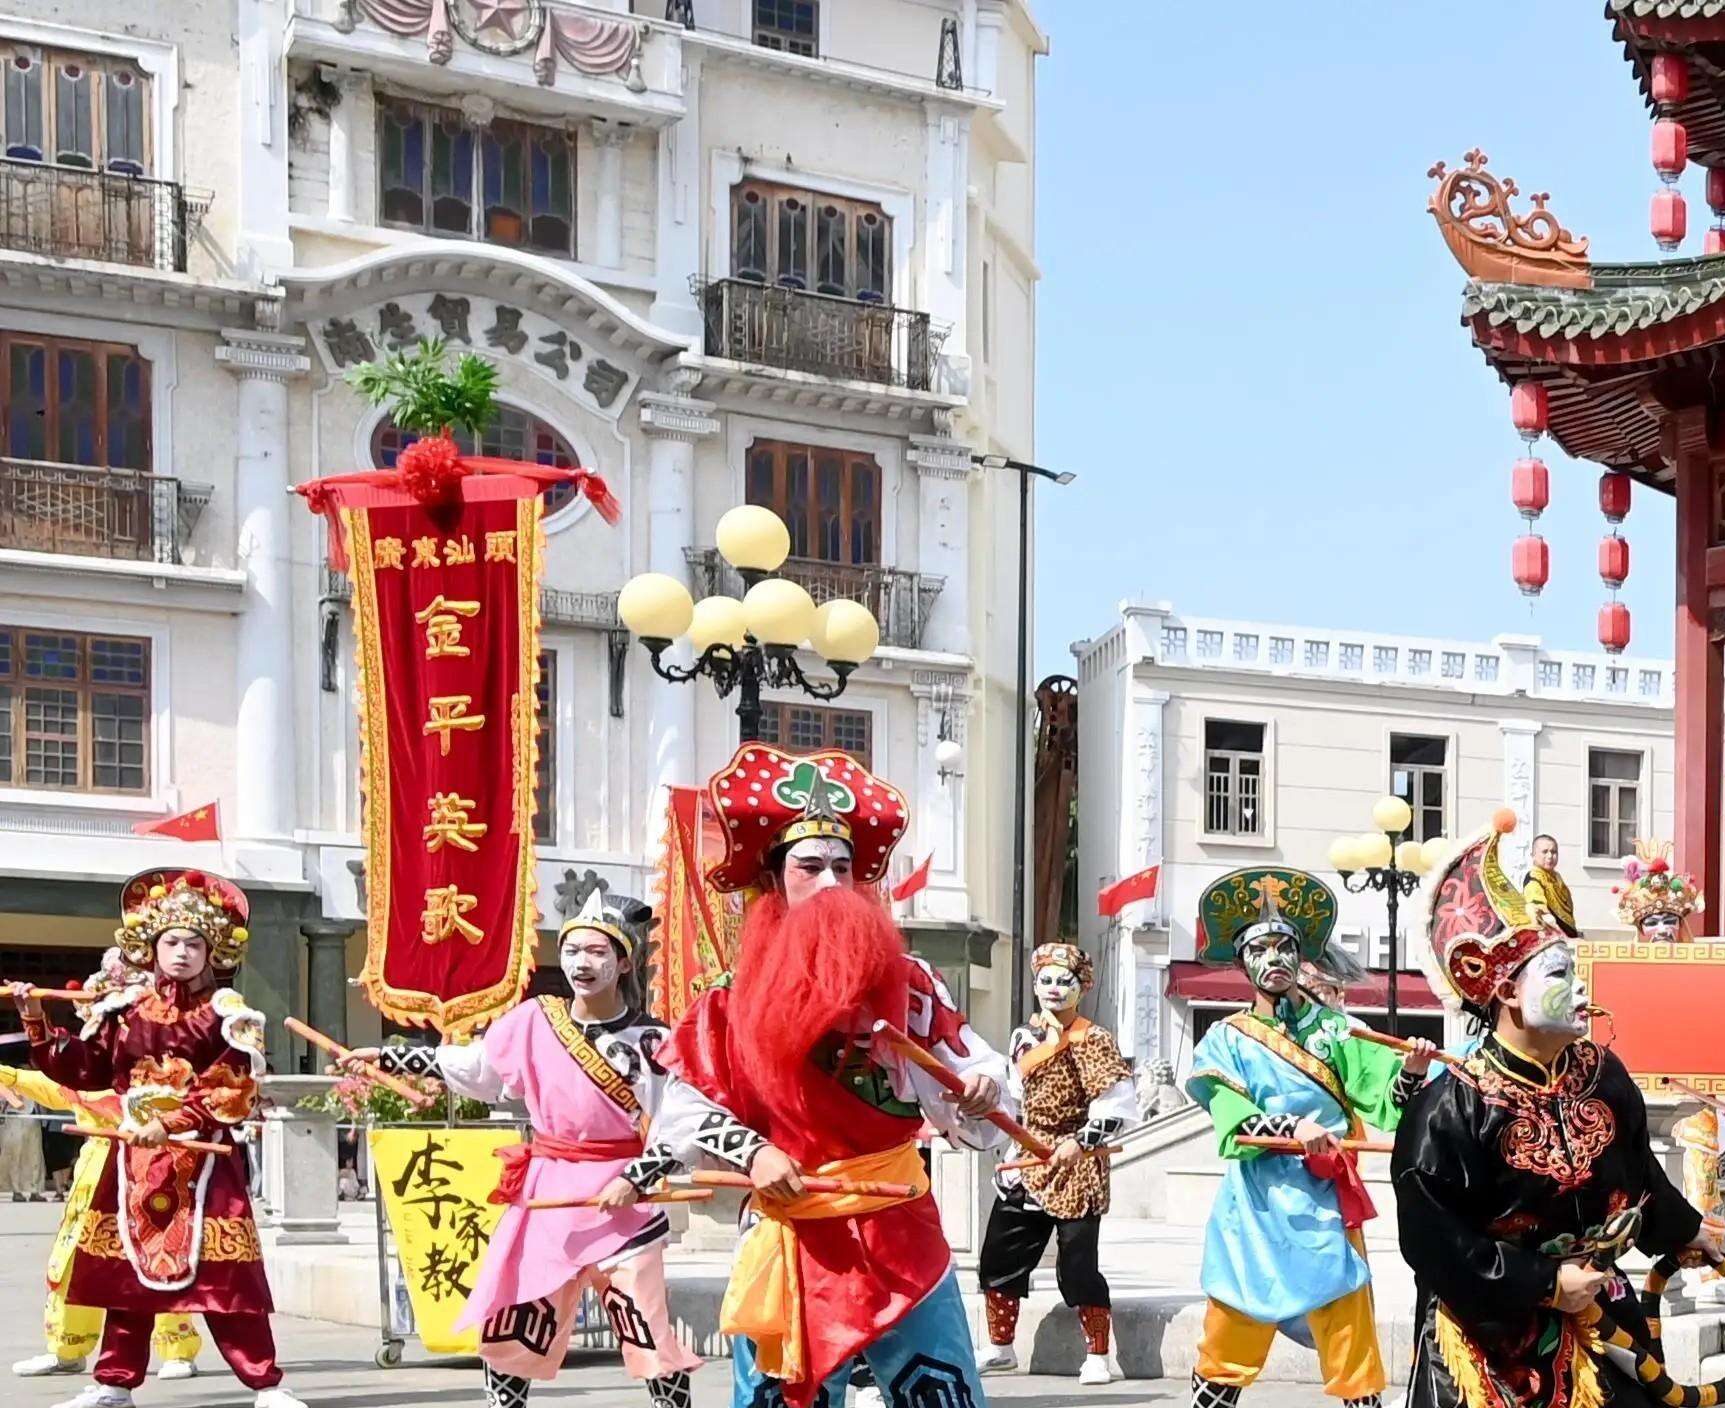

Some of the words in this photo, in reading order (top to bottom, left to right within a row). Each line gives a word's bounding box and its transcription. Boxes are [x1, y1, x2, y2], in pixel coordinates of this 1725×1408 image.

[373, 530, 518, 570] 廣東汕頭
[415, 595, 488, 947] 金平英歌
